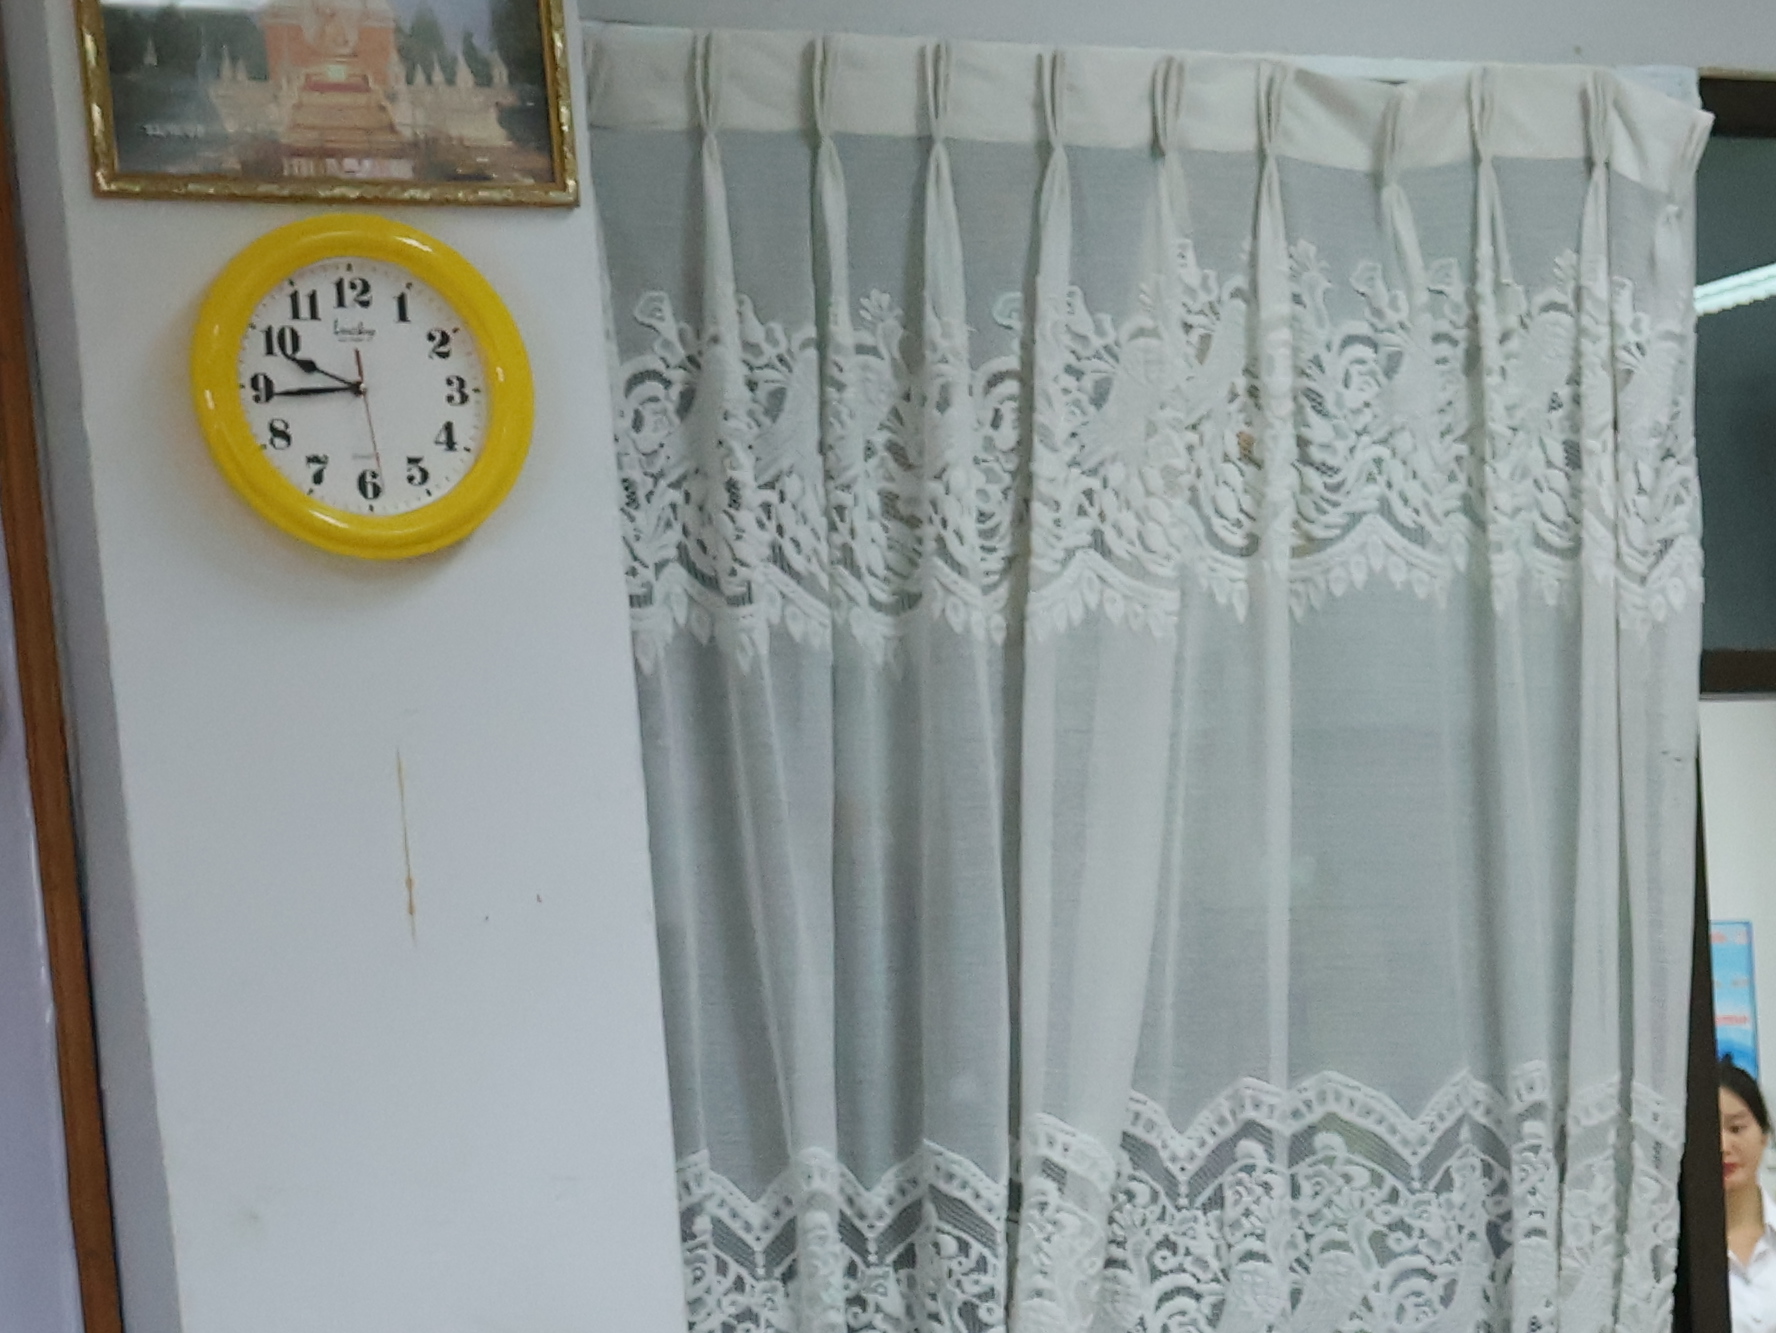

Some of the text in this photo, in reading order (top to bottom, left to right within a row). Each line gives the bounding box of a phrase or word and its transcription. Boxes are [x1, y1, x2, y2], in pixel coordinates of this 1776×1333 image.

[289, 288, 321, 321] 11
[334, 277, 374, 309] 12
[394, 290, 411, 323] 1
[262, 324, 301, 358] 10
[427, 327, 452, 359] 2
[250, 372, 275, 404] 9
[445, 374, 470, 406] 3
[268, 418, 292, 450] 8
[434, 420, 458, 451] 4
[305, 454, 329, 485] 7
[357, 468, 383, 500] 6
[406, 455, 430, 486] 5
